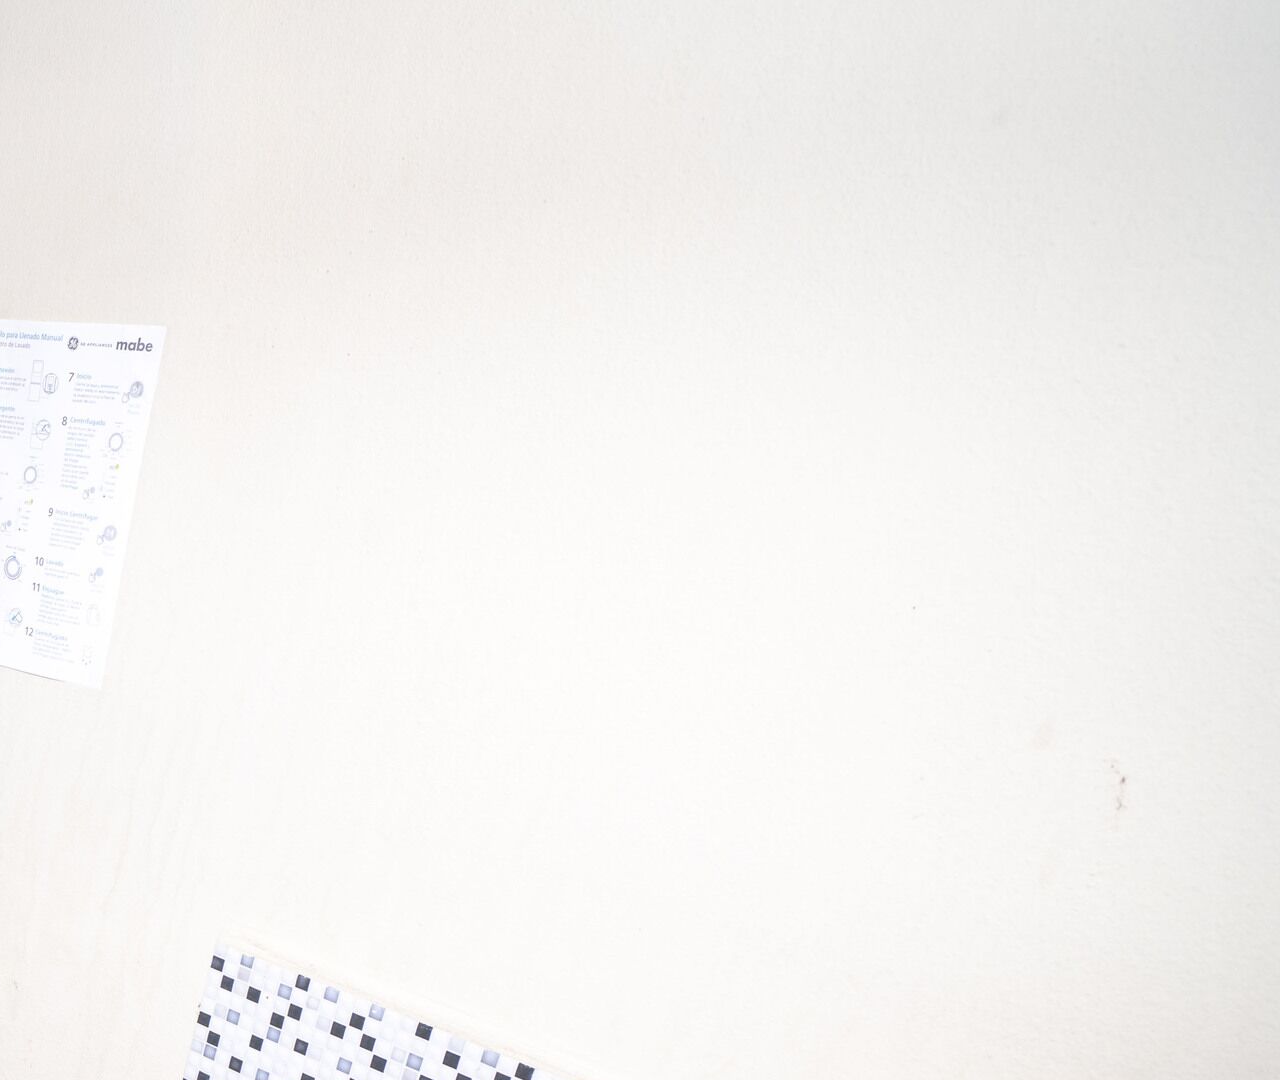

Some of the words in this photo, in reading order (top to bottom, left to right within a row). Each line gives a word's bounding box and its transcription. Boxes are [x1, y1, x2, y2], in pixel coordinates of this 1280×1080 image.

[6, 332, 18, 340] para
[19, 331, 40, 340] Llenado
[41, 333, 64, 341] Manual
[116, 337, 153, 352] mabe
[68, 372, 75, 382] 7
[61, 416, 68, 426] 8
[48, 507, 54, 517] 9
[35, 556, 44, 566] 10
[32, 582, 40, 592] 11
[25, 626, 34, 637] 12
